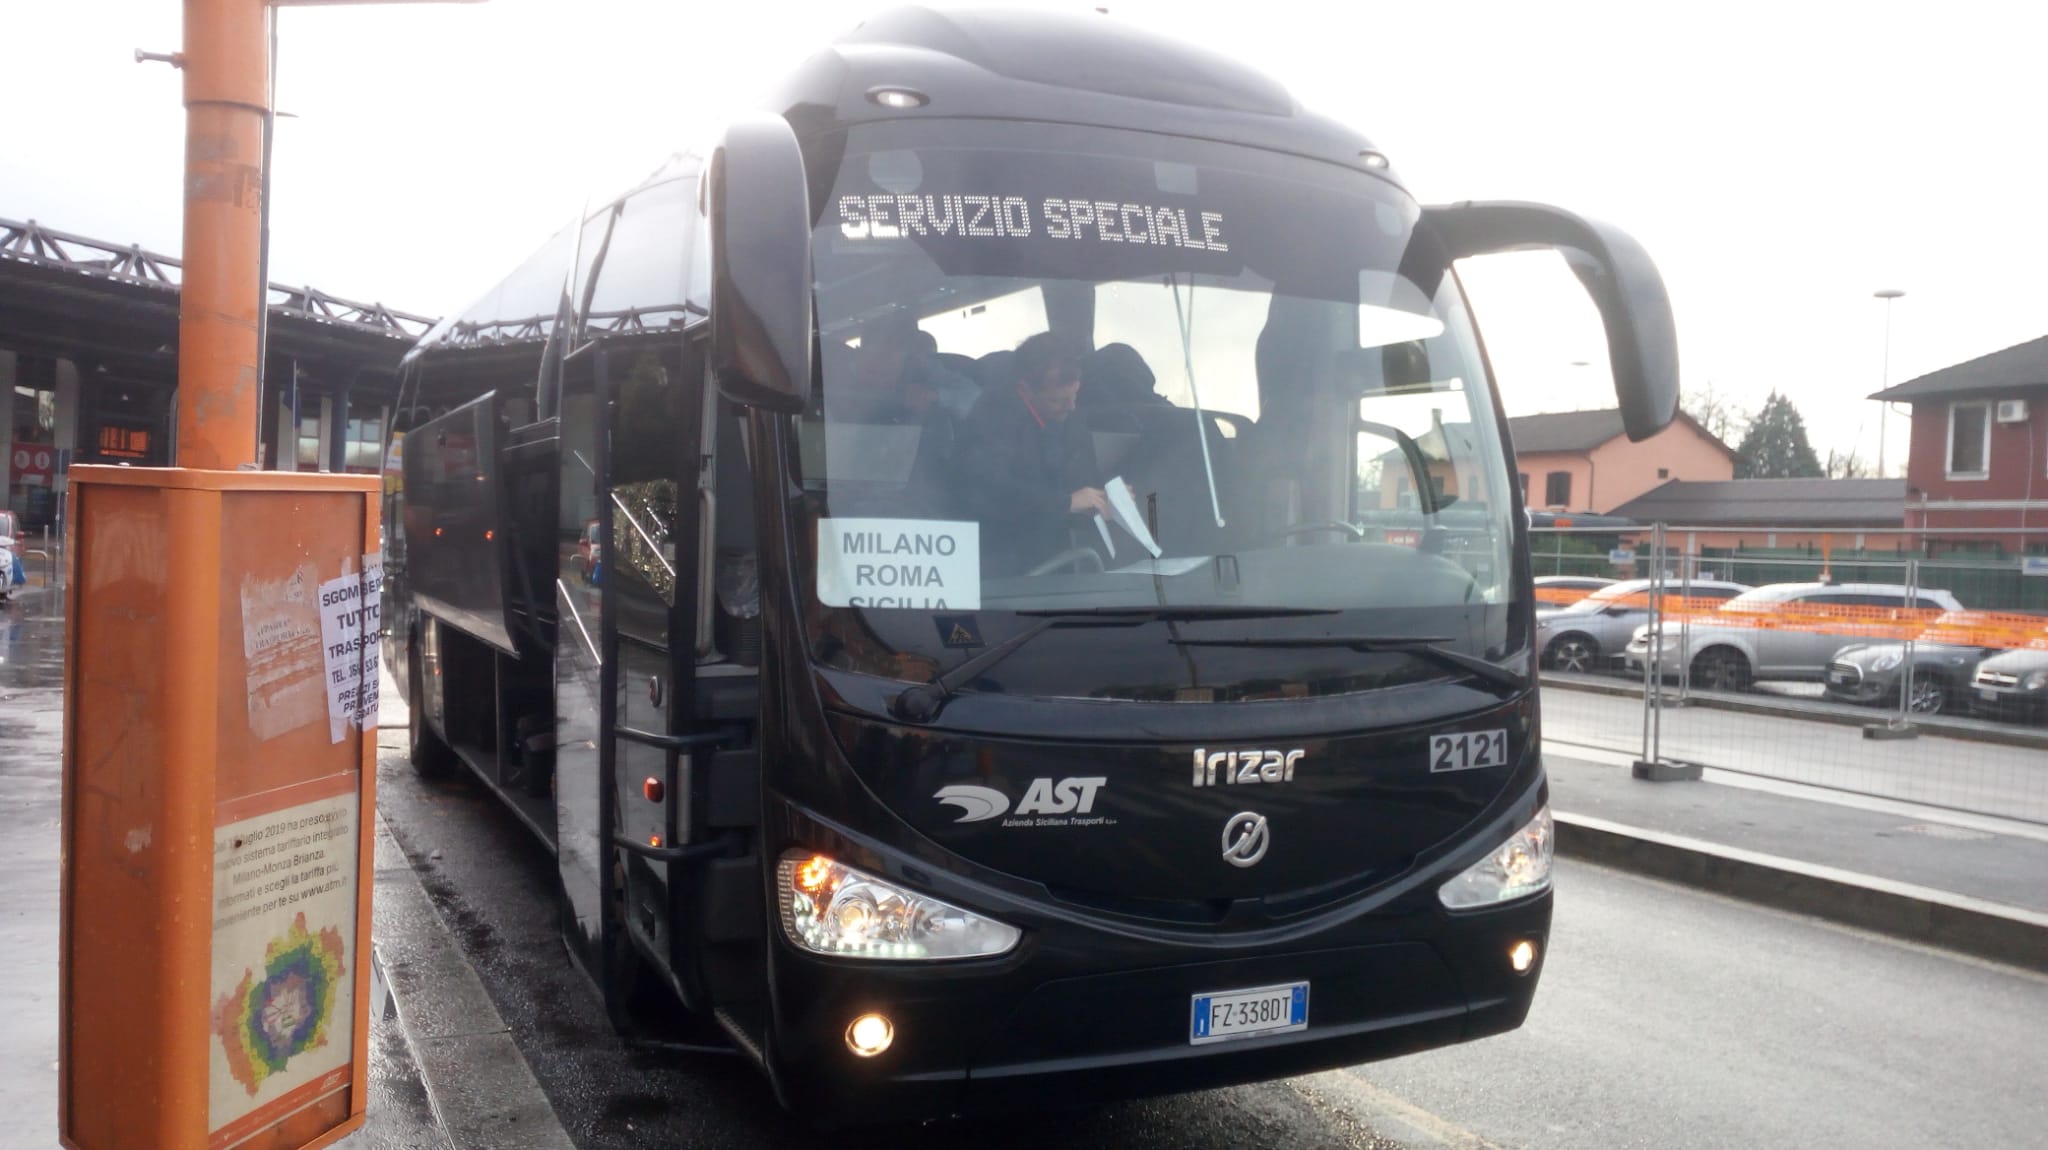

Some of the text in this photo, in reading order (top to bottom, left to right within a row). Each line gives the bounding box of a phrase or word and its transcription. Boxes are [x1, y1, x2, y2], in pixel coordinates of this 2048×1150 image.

[839, 194, 1229, 252] SERVIZIO SPECIALE
[843, 532, 956, 556] MILANO
[856, 564, 945, 588] ROMA
[331, 669, 347, 685] TEL.
[338, 682, 371, 704] PREZI
[343, 690, 379, 713] PRVEN
[1434, 731, 1504, 769] 2121
[1192, 748, 1305, 787] Irizar
[1014, 777, 1107, 815] AST
[264, 821, 286, 839] 2019
[299, 813, 325, 830] preso
[1001, 817, 1034, 828] Azienda
[1070, 815, 1104, 827] Trasporti
[243, 843, 276, 864] sistema
[256, 885, 263, 896] e
[264, 874, 290, 894] scegli
[300, 864, 325, 882] tariffa
[263, 898, 278, 914] per
[278, 895, 288, 908] te
[288, 890, 299, 904] su
